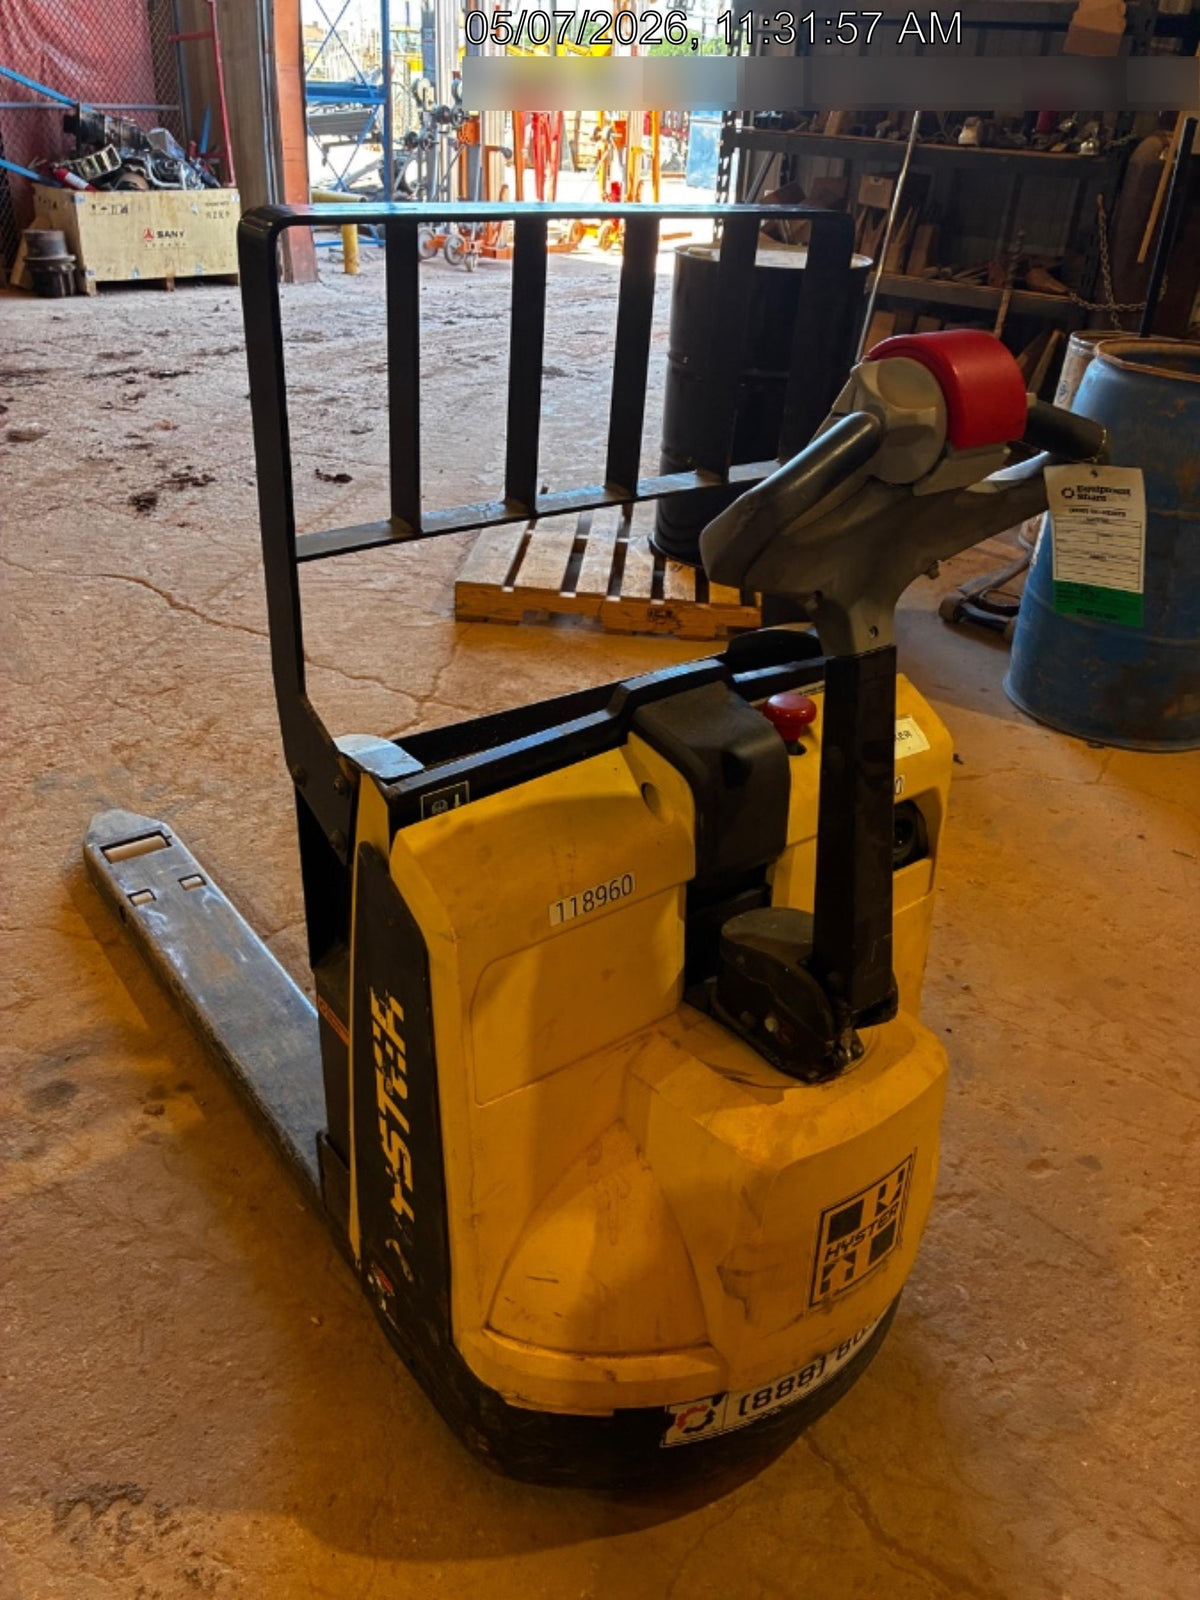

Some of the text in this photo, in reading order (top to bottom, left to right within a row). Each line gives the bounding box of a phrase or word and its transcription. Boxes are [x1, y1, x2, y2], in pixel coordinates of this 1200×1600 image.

[156, 230, 185, 239] SANY
[554, 873, 635, 923] 118960
[824, 1200, 900, 1262] HYSTER
[738, 1356, 827, 1416] (888)
